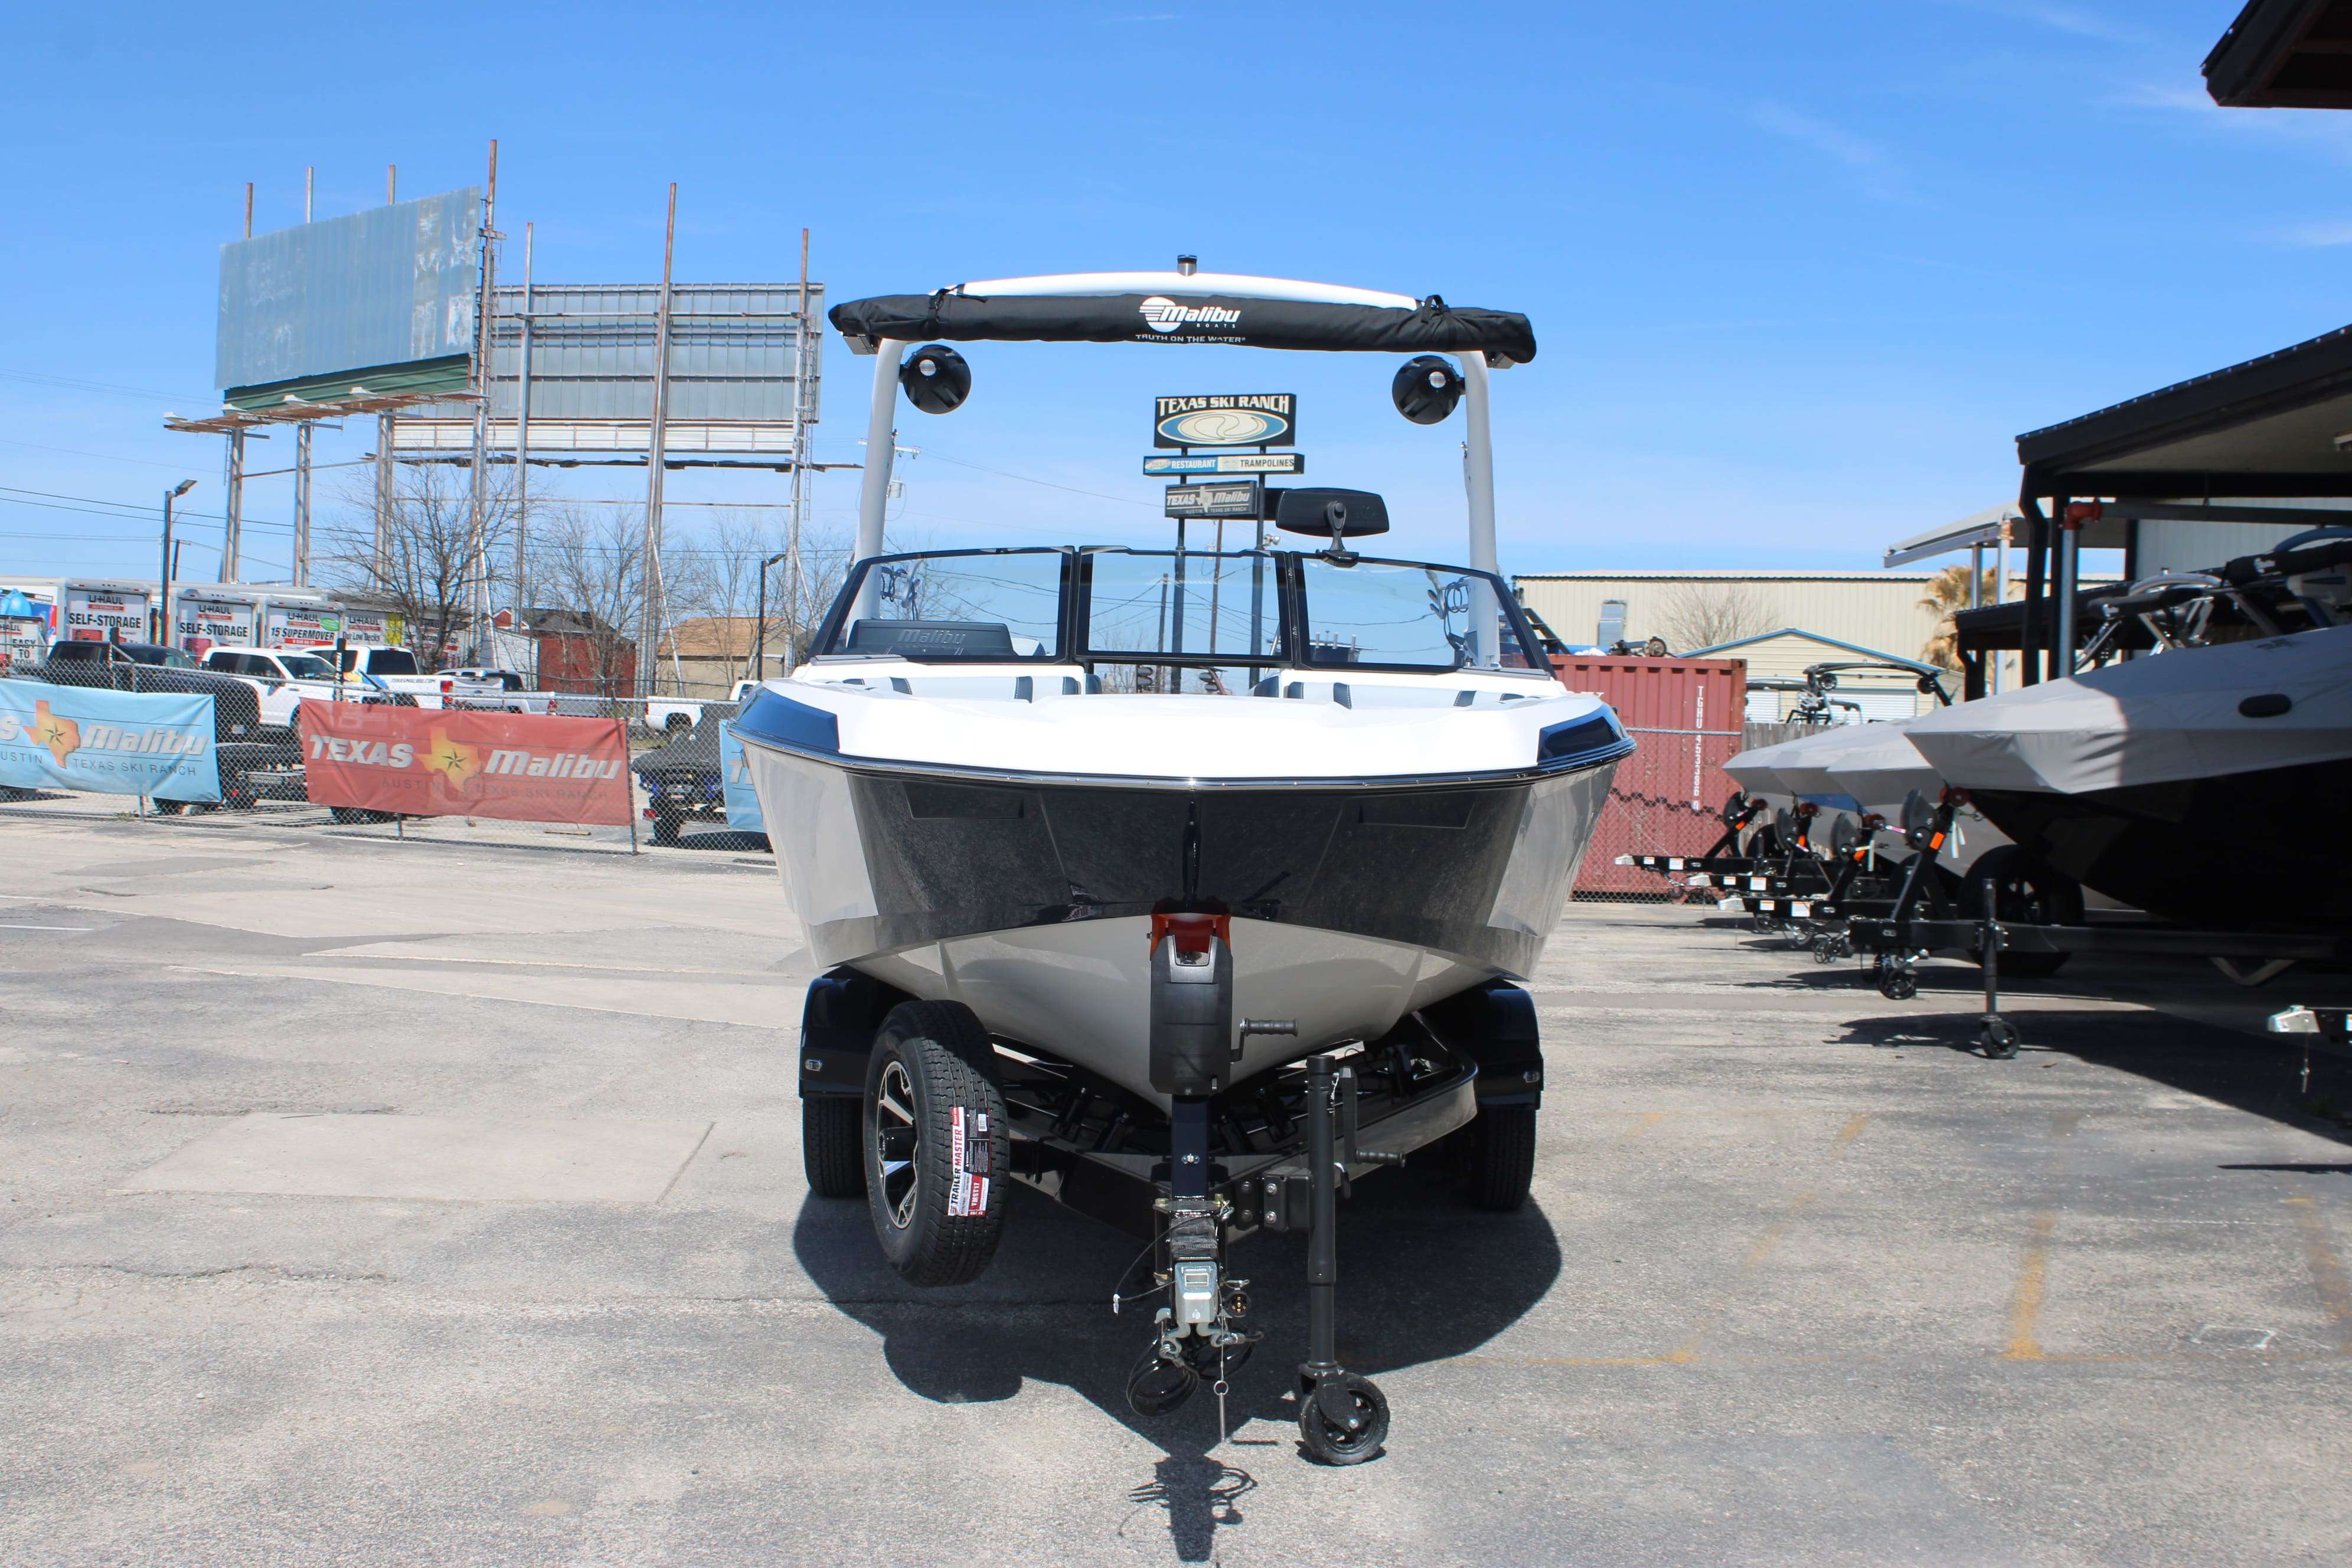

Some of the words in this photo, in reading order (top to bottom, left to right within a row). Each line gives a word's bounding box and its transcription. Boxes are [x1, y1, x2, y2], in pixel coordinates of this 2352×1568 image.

[1158, 305, 1241, 322] Malibu
[1157, 397, 1207, 417] TEXAS
[1210, 396, 1234, 408] SKI
[1239, 395, 1290, 414] RANCH
[1171, 459, 1216, 469] RESTAURANT
[1240, 459, 1295, 467] TRAMPOLINES
[1167, 494, 1196, 506] TEXAS
[1214, 491, 1250, 502] Malibu
[69, 613, 141, 628] SELF-STORAGE
[179, 623, 248, 637] SELF-STORAGE
[282, 628, 335, 641] SUPERMOVER
[897, 629, 966, 644] Malibu
[12, 639, 36, 649] EASY
[18, 649, 30, 658] TO
[82, 724, 209, 756] Malibu
[0, 750, 43, 764] USTIN
[73, 758, 115, 771] TEXAS
[121, 762, 144, 772] SKI
[151, 765, 197, 776] RANCH
[309, 734, 414, 768] TEXAS
[484, 749, 622, 779] Malibu
[383, 778, 440, 790] AUSTIN
[954, 1130, 962, 1167] MASTER
[951, 1168, 961, 1204] TRAILER
